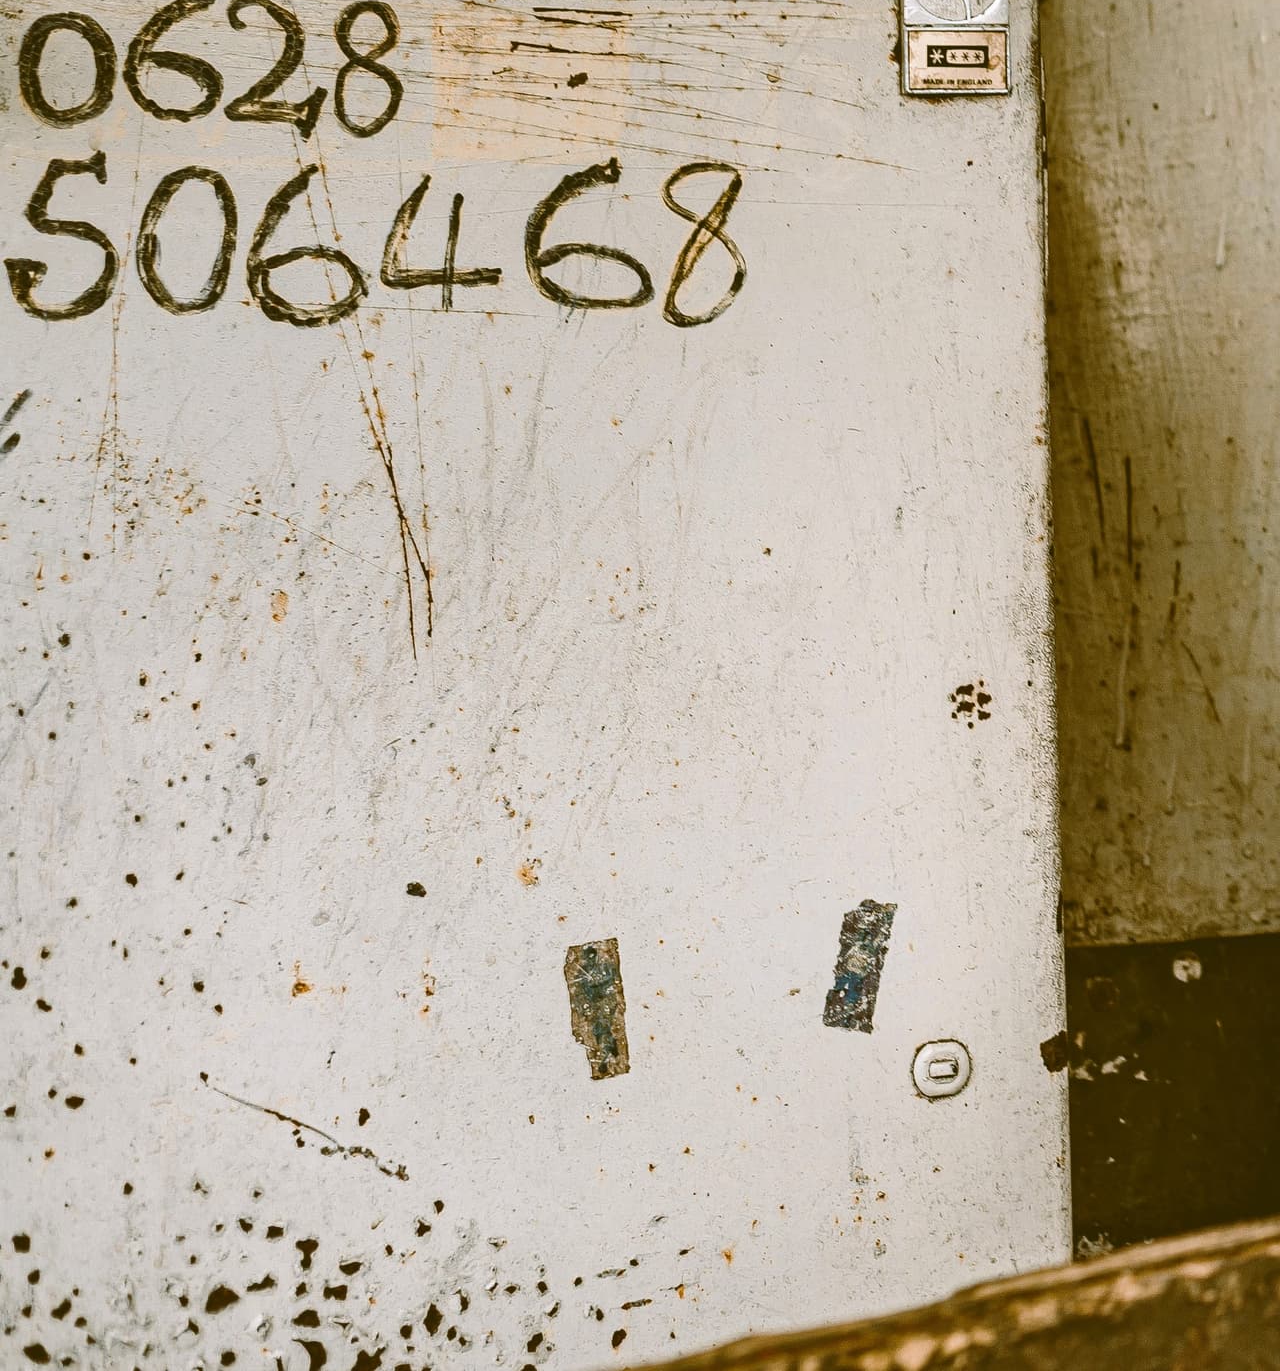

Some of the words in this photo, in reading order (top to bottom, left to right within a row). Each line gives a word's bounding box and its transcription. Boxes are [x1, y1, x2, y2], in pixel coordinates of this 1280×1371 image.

[923, 78, 944, 86] MADE
[947, 78, 955, 86] IN
[957, 78, 993, 86] ENGLAND
[4, 150, 747, 327] 506468
